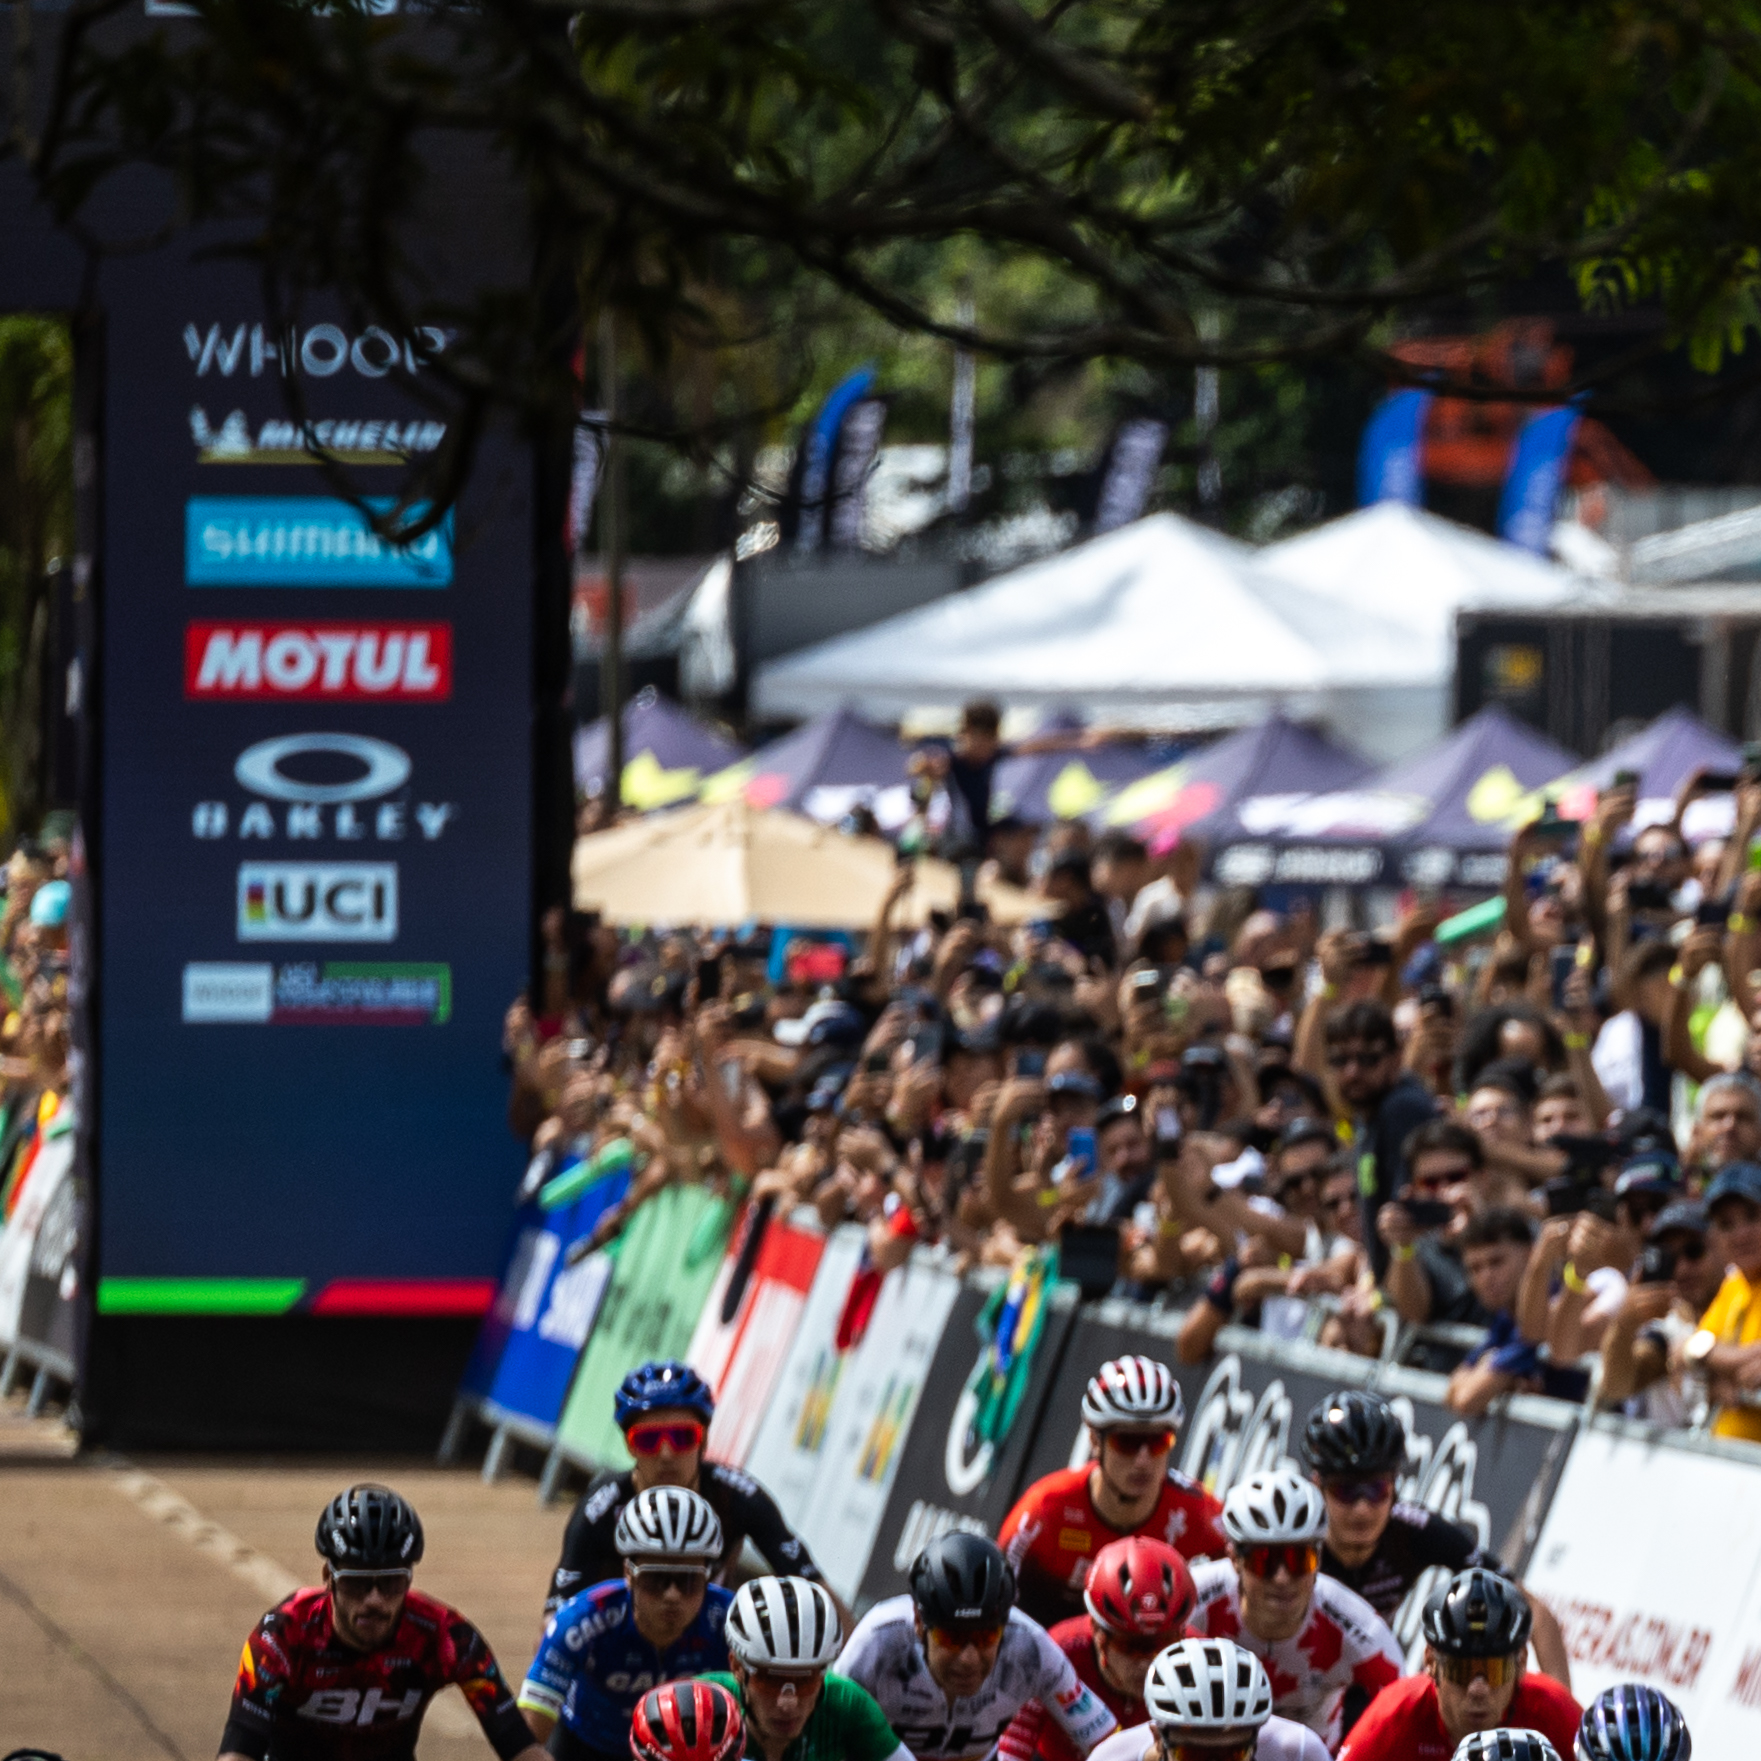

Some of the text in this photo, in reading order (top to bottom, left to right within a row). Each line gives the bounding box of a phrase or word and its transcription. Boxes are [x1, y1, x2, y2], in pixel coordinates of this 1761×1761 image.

[196, 630, 440, 691] MOTUL
[192, 802, 450, 840] OAKLEY
[273, 880, 385, 924] UCI
[297, 1687, 424, 1728] BH
